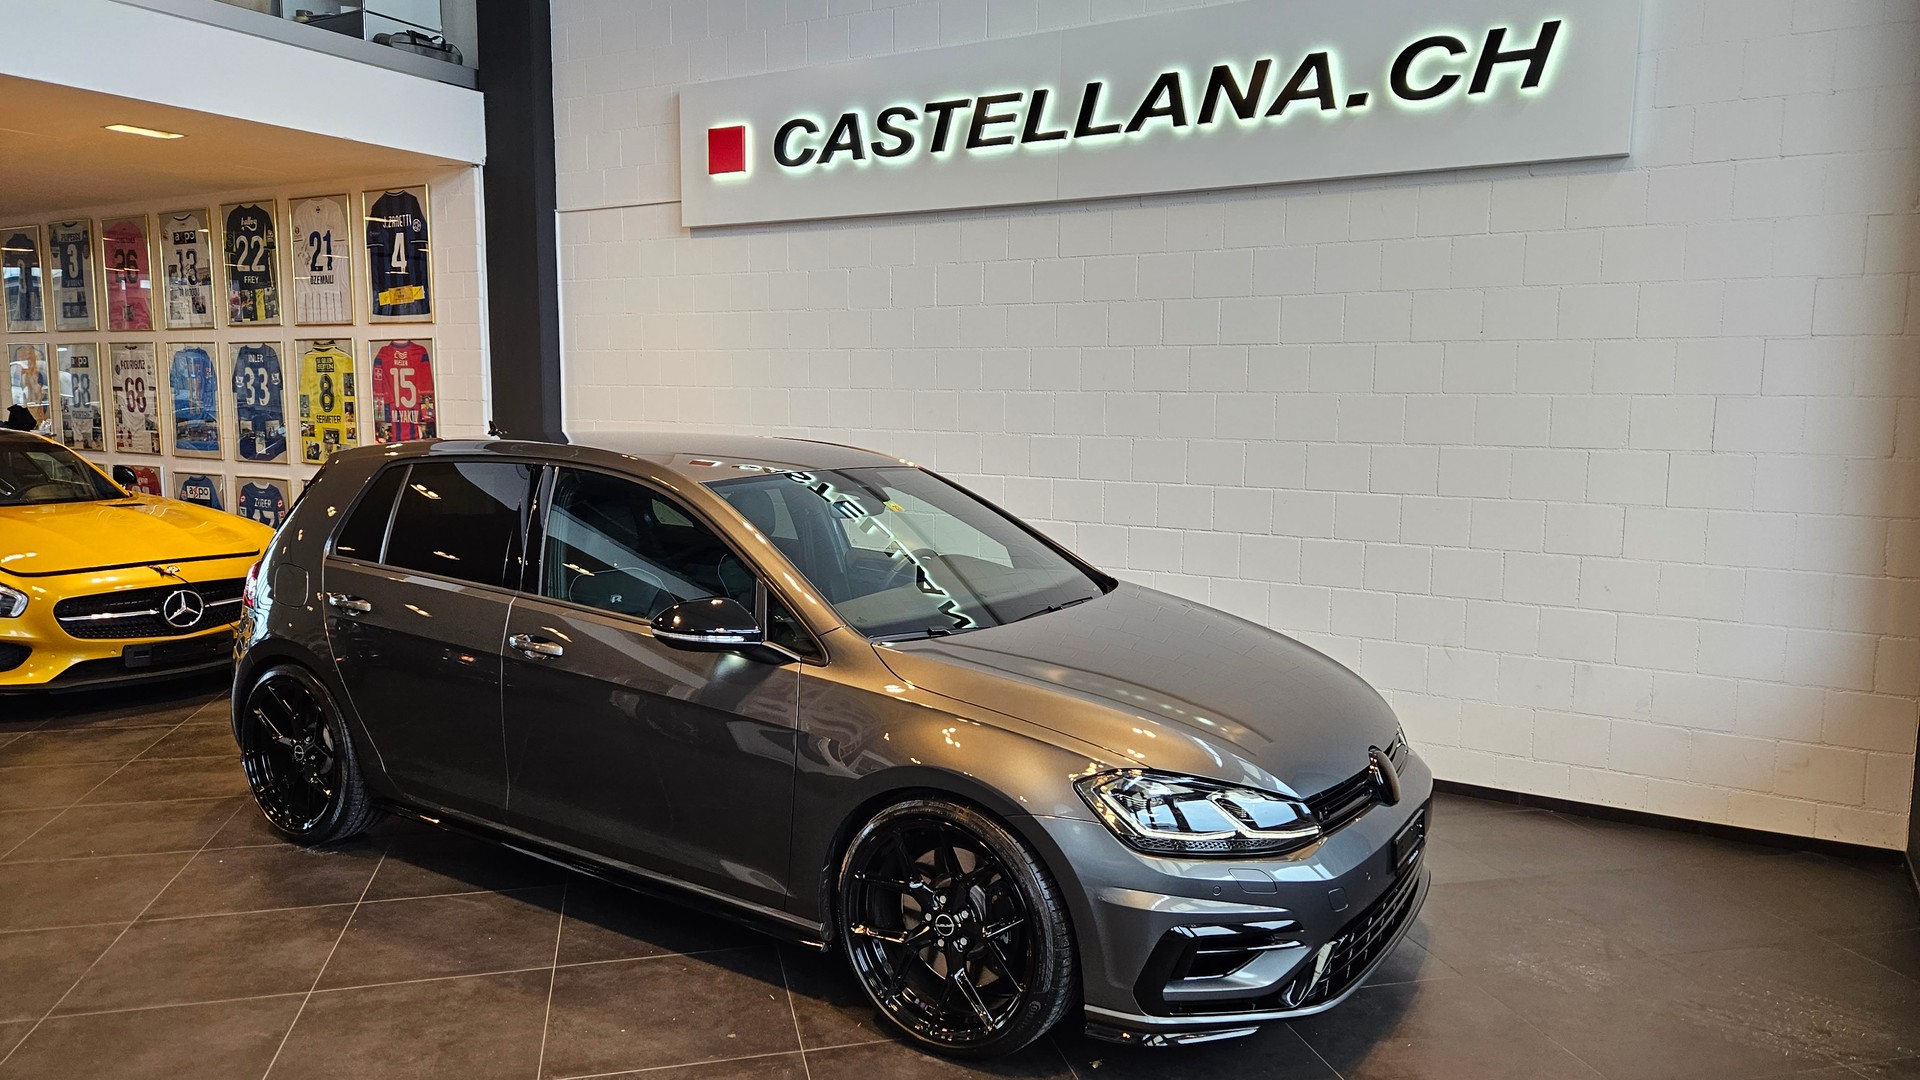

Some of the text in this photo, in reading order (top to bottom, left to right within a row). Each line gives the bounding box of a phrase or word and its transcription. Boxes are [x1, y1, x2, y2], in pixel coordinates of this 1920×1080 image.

[773, 20, 1562, 168] CASTELLANA.CH
[67, 243, 79, 279] 3
[114, 248, 139, 284] 26
[176, 248, 198, 285] 13
[236, 235, 266, 272] 22
[309, 230, 333, 272] 21
[391, 232, 408, 274] 4
[244, 275, 259, 284] FREY
[124, 376, 147, 414] 68
[244, 366, 270, 406] 33
[318, 373, 335, 412] 8
[389, 367, 417, 408] 15
